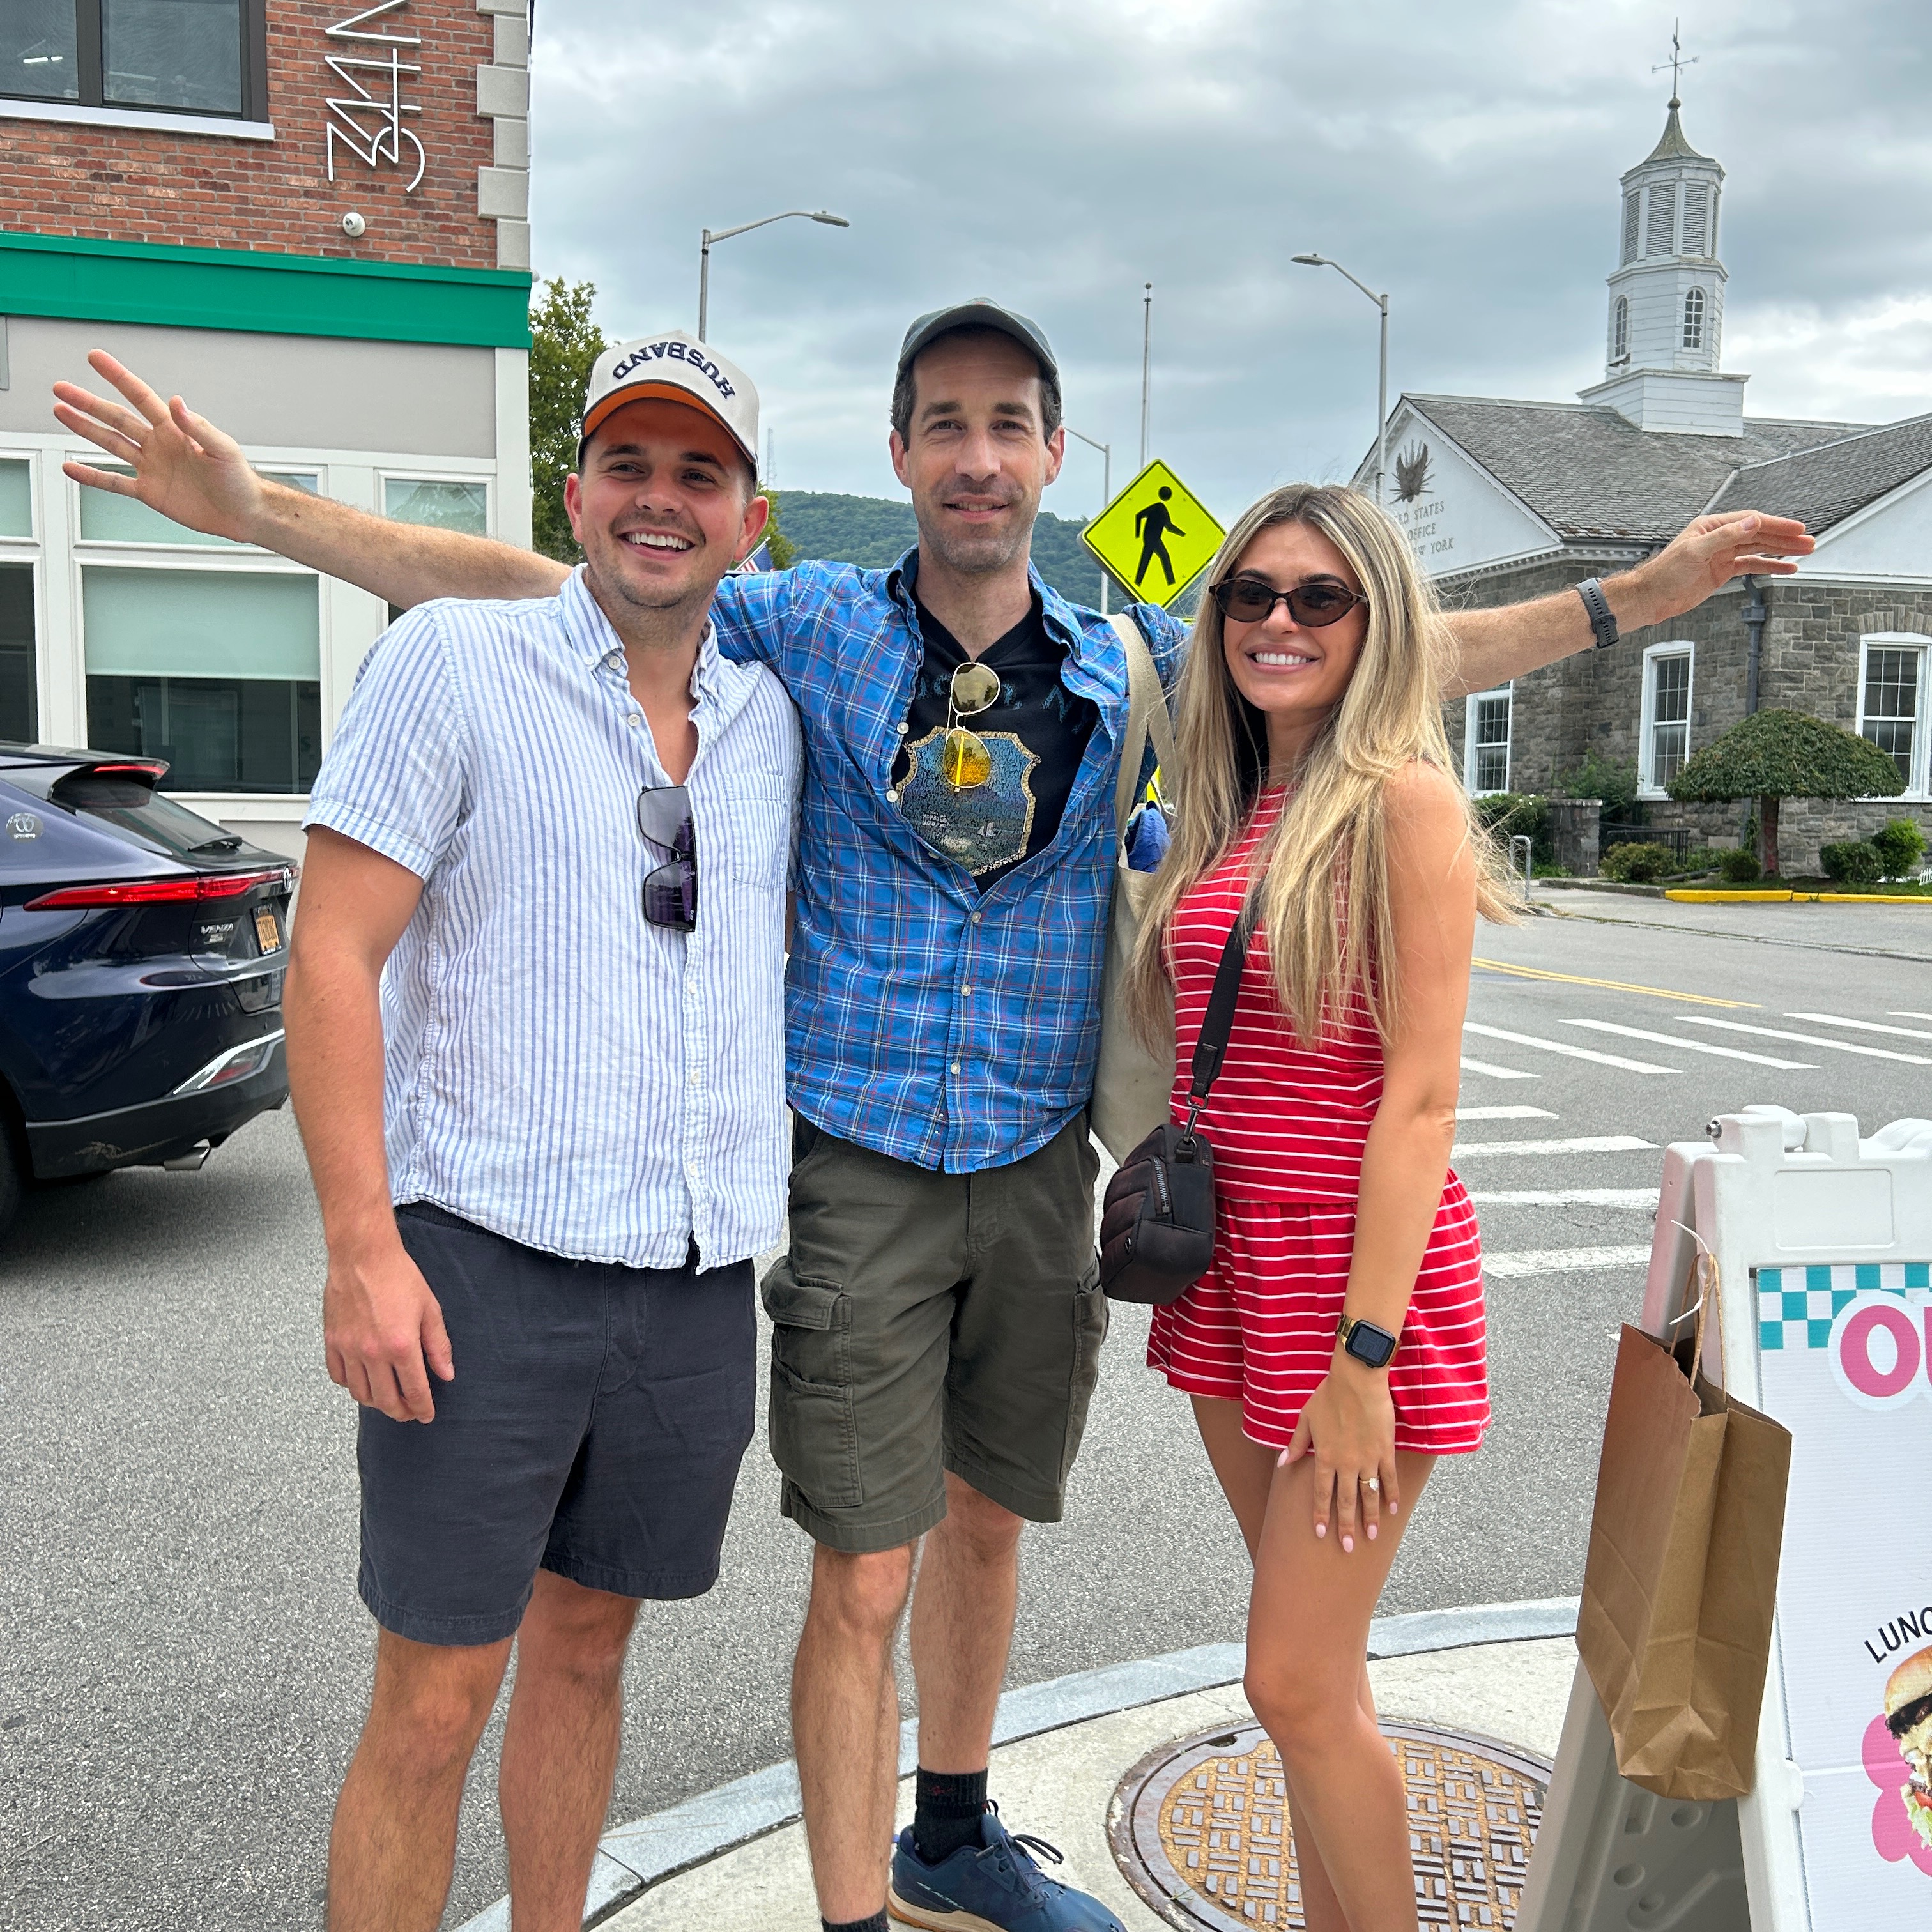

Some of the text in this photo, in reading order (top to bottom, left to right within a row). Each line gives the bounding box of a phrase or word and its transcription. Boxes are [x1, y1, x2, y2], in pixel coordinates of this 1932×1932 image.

[613, 342, 735, 399] HUSBAND
[1414, 500, 1445, 521] STATES
[1407, 523, 1436, 542] OFFICE
[1430, 537, 1453, 554] YORK
[201, 923, 234, 935] VENZA
[1839, 1305, 1932, 1398] O
